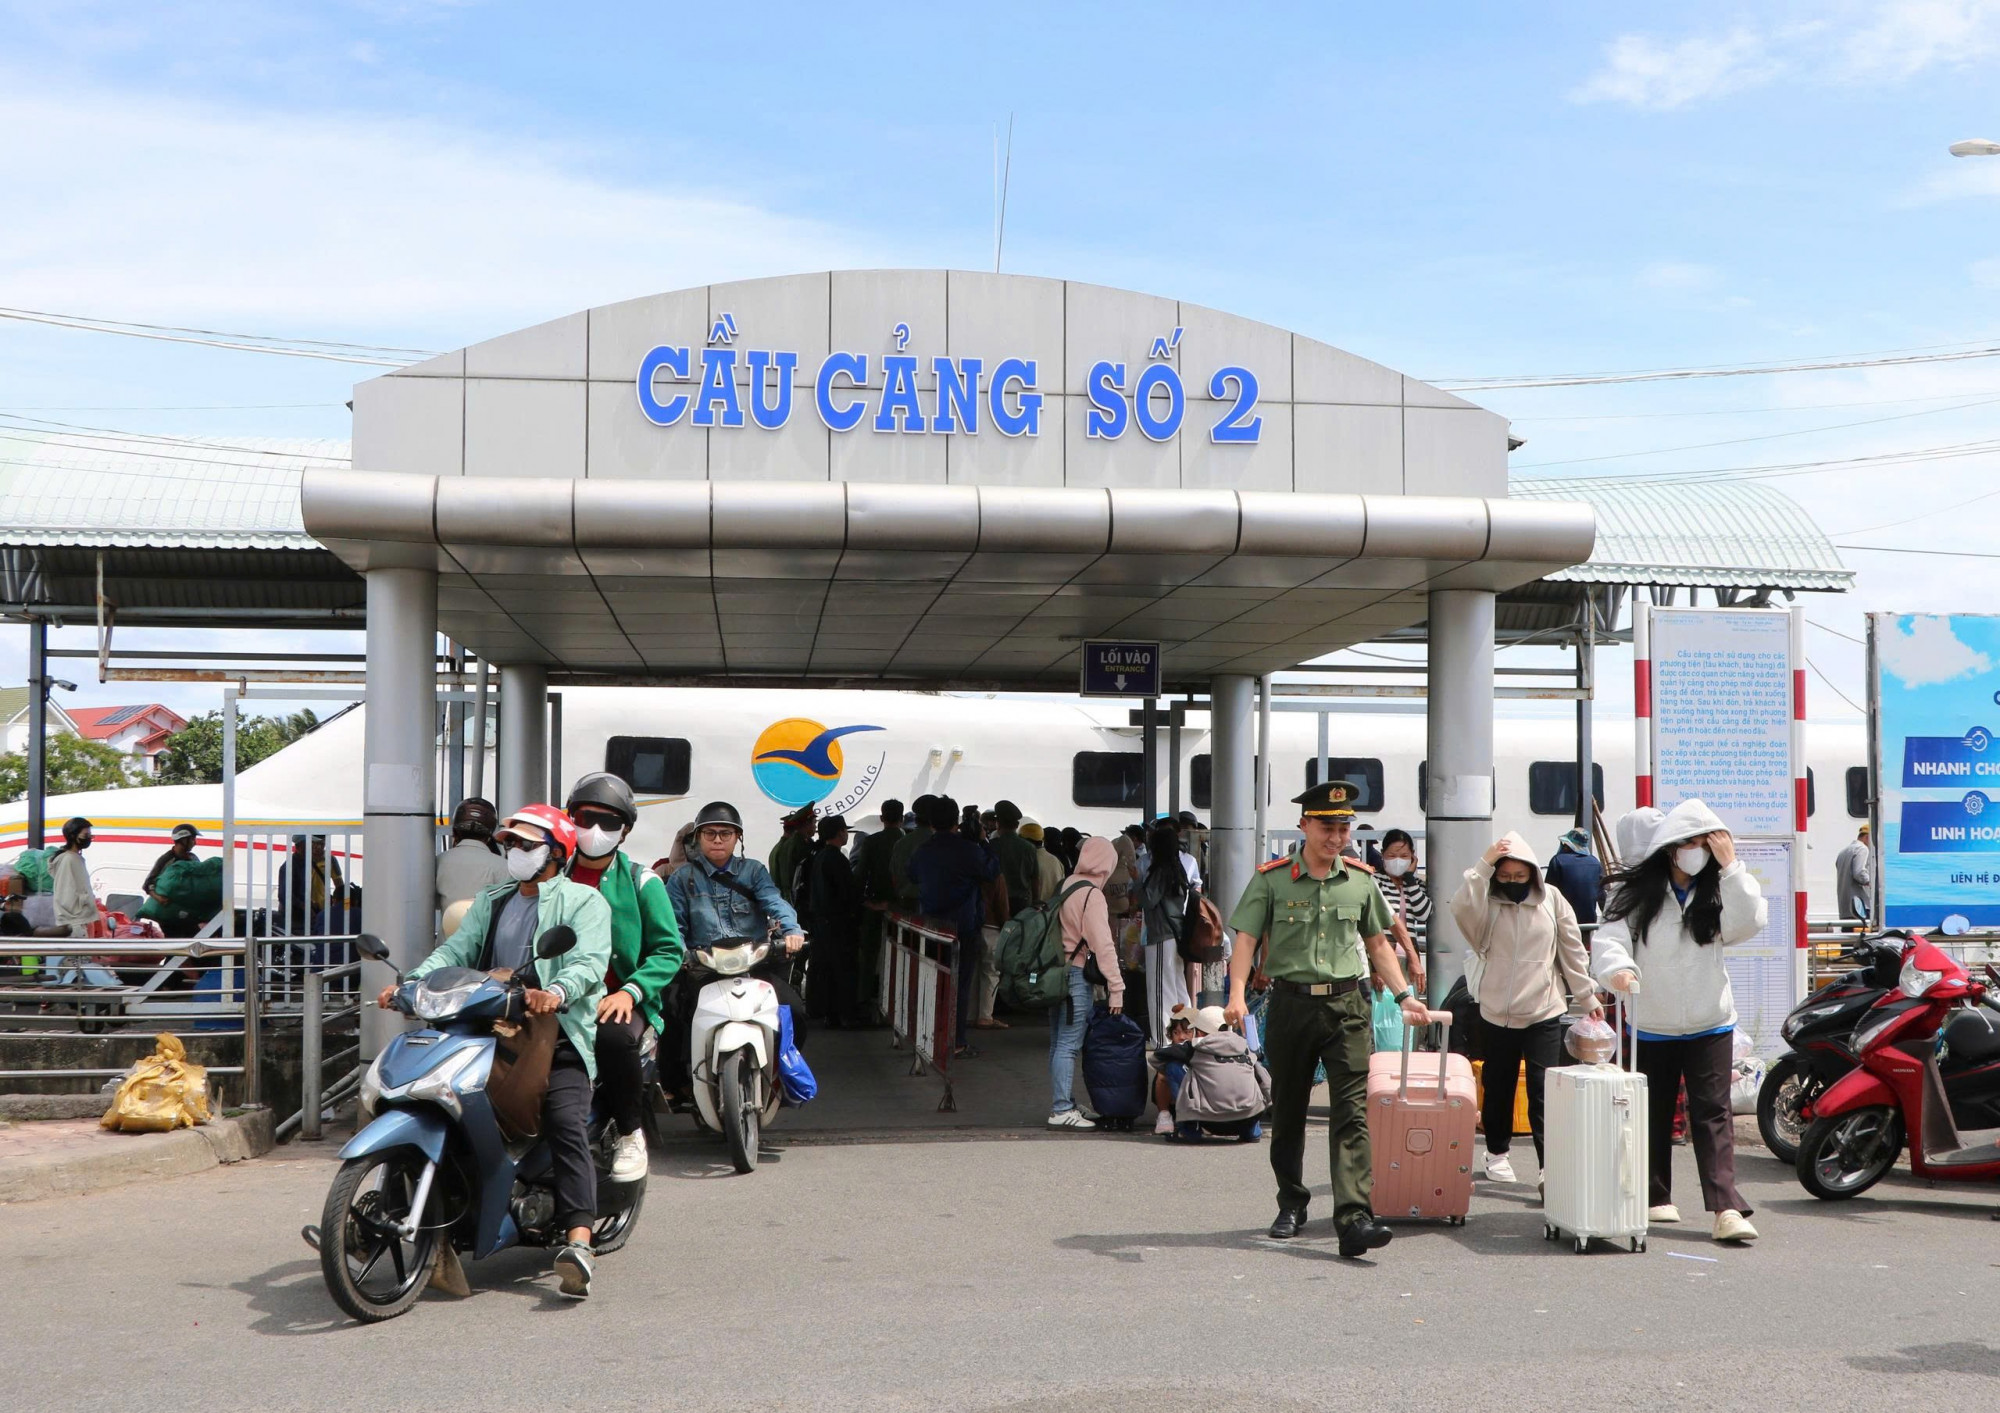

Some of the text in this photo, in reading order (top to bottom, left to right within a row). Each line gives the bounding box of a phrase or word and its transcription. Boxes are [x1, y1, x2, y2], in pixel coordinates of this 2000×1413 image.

[636, 313, 1263, 444] CẦU CẢNG SỐ 2
[1100, 648, 1151, 664] LỐI VÀO
[1105, 665, 1146, 673] ENTRANCE
[1913, 762, 1971, 775] NHANH
[1931, 827, 1966, 840] LINH
[1951, 871, 1973, 883] LIÊN
[1976, 871, 1989, 885] HỆ
